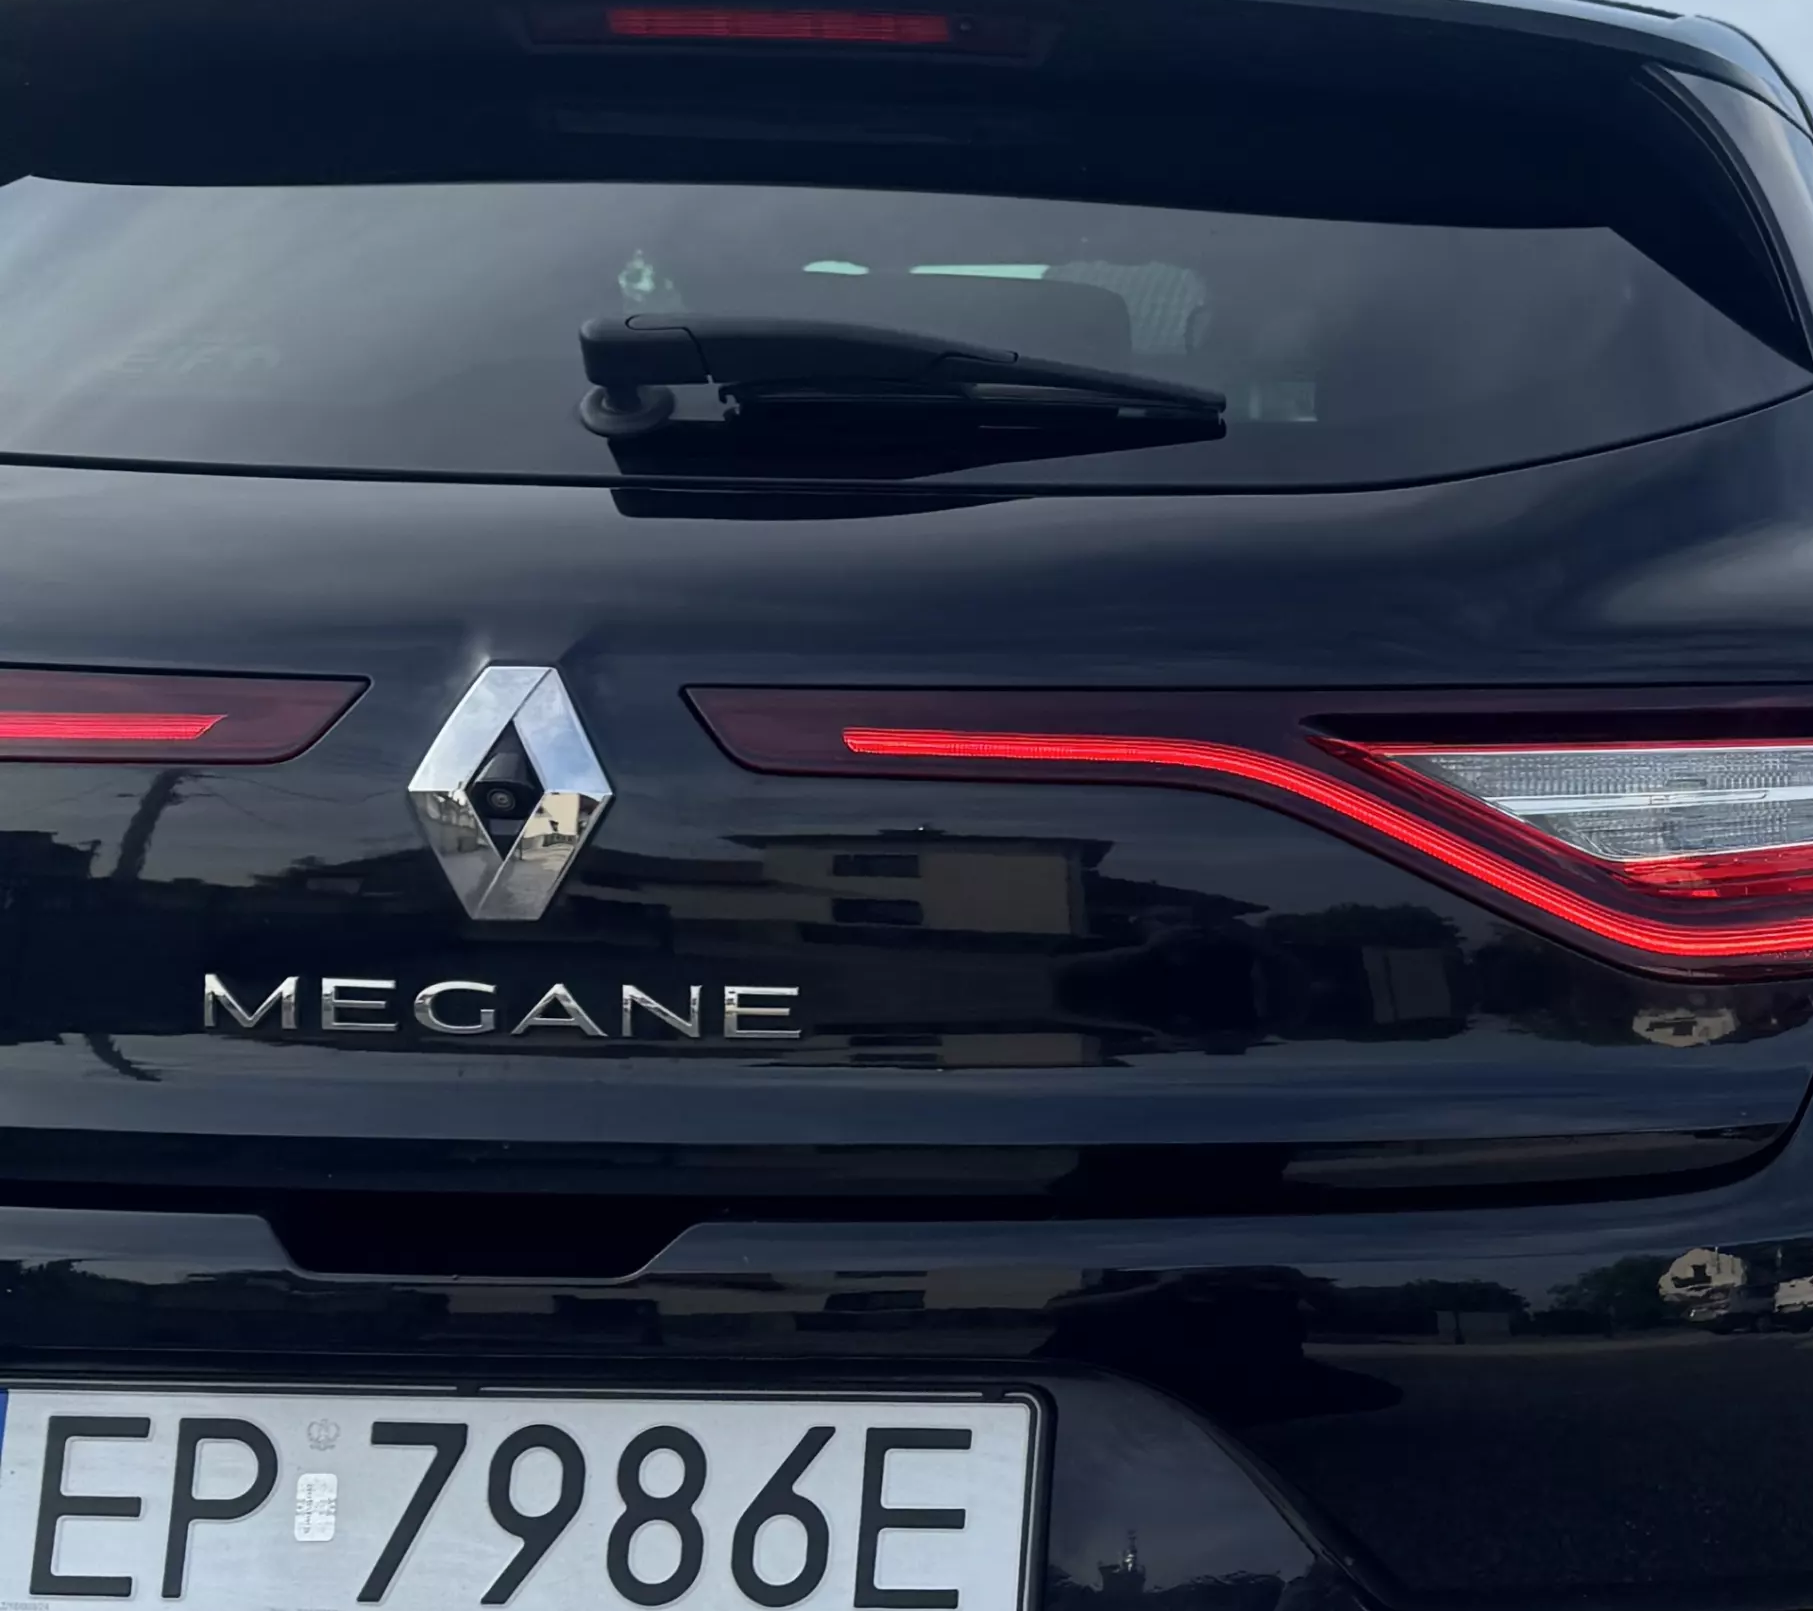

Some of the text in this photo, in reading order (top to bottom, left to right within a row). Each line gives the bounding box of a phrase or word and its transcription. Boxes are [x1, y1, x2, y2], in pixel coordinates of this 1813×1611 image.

[204, 973, 802, 1040] MEGANE
[29, 1415, 974, 1610] EP 7986E
